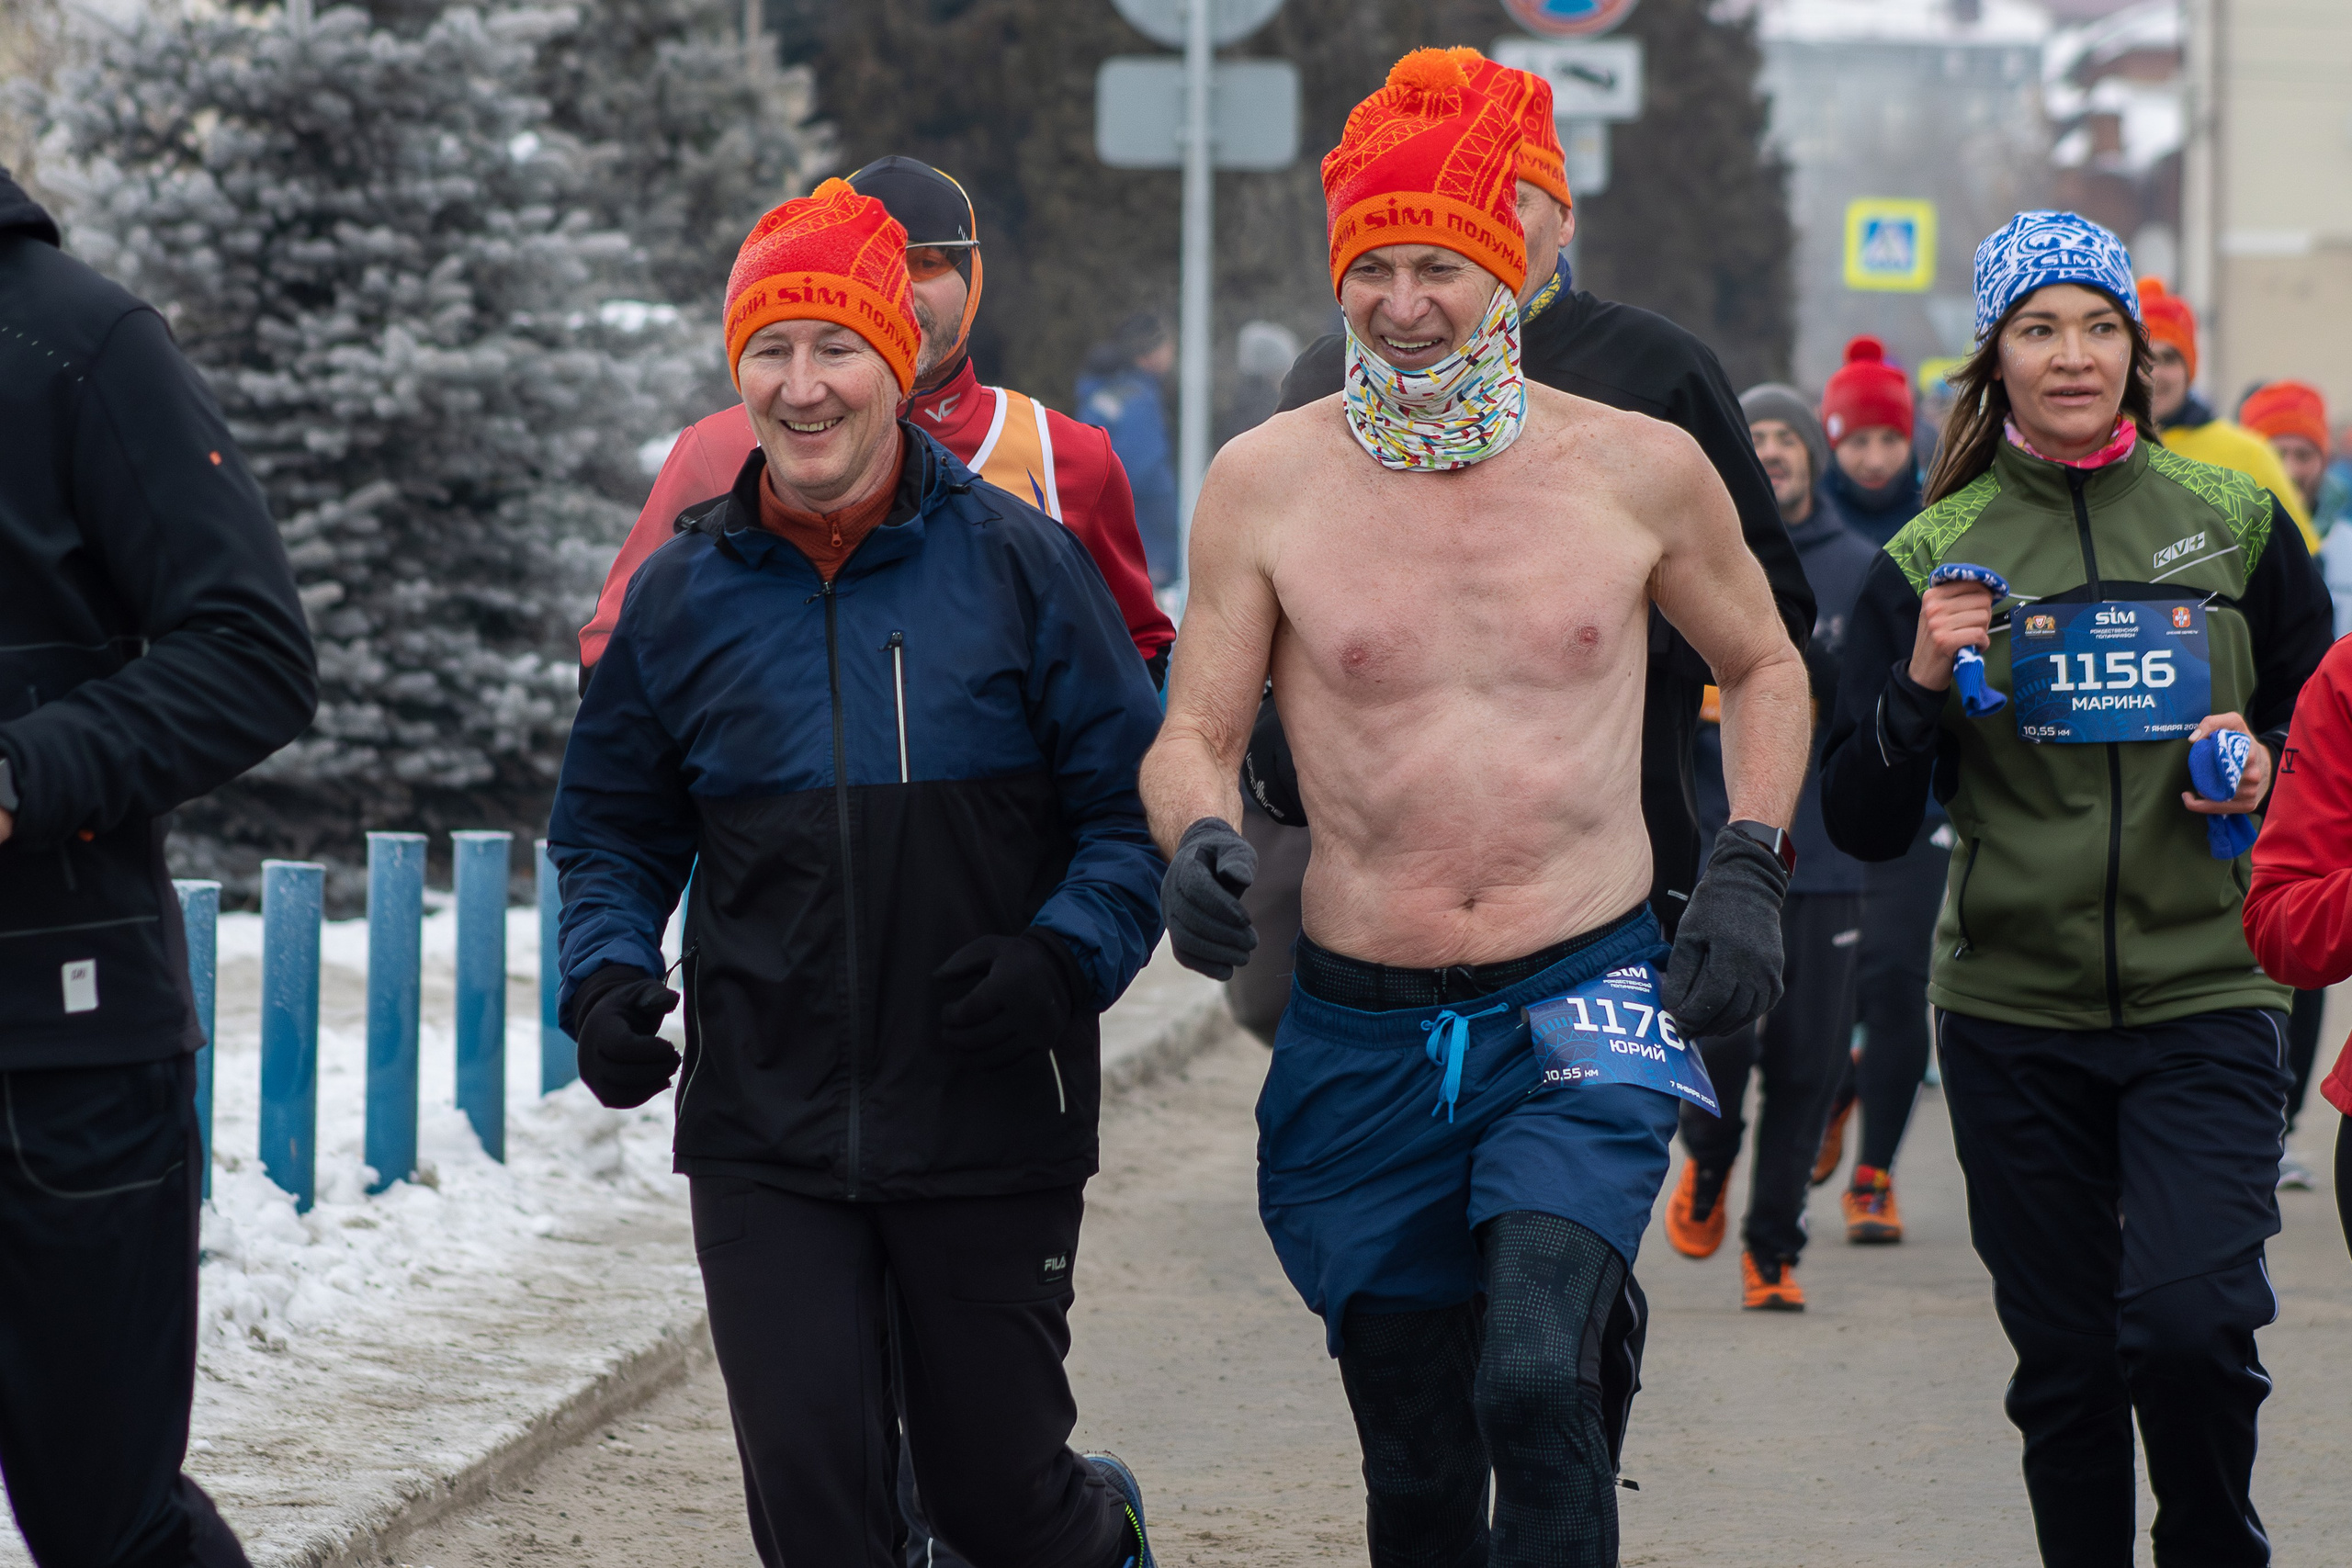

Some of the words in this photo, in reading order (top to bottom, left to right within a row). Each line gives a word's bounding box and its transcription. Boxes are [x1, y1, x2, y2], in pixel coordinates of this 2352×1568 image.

[2050, 649, 2176, 691] 1156
[2072, 694, 2156, 711] МАРИНА
[2023, 726, 2055, 737] 10,55
[2152, 724, 2183, 732] ЯНВАРЯ
[2183, 723, 2199, 731] 202
[1566, 998, 1686, 1052] 1176
[1609, 1039, 1666, 1063] ЮРИЙ
[1545, 1067, 1581, 1081] 10,55
[1676, 1082, 1701, 1099] ЯНВАРЯ
[1044, 1255, 1067, 1271] FILA
